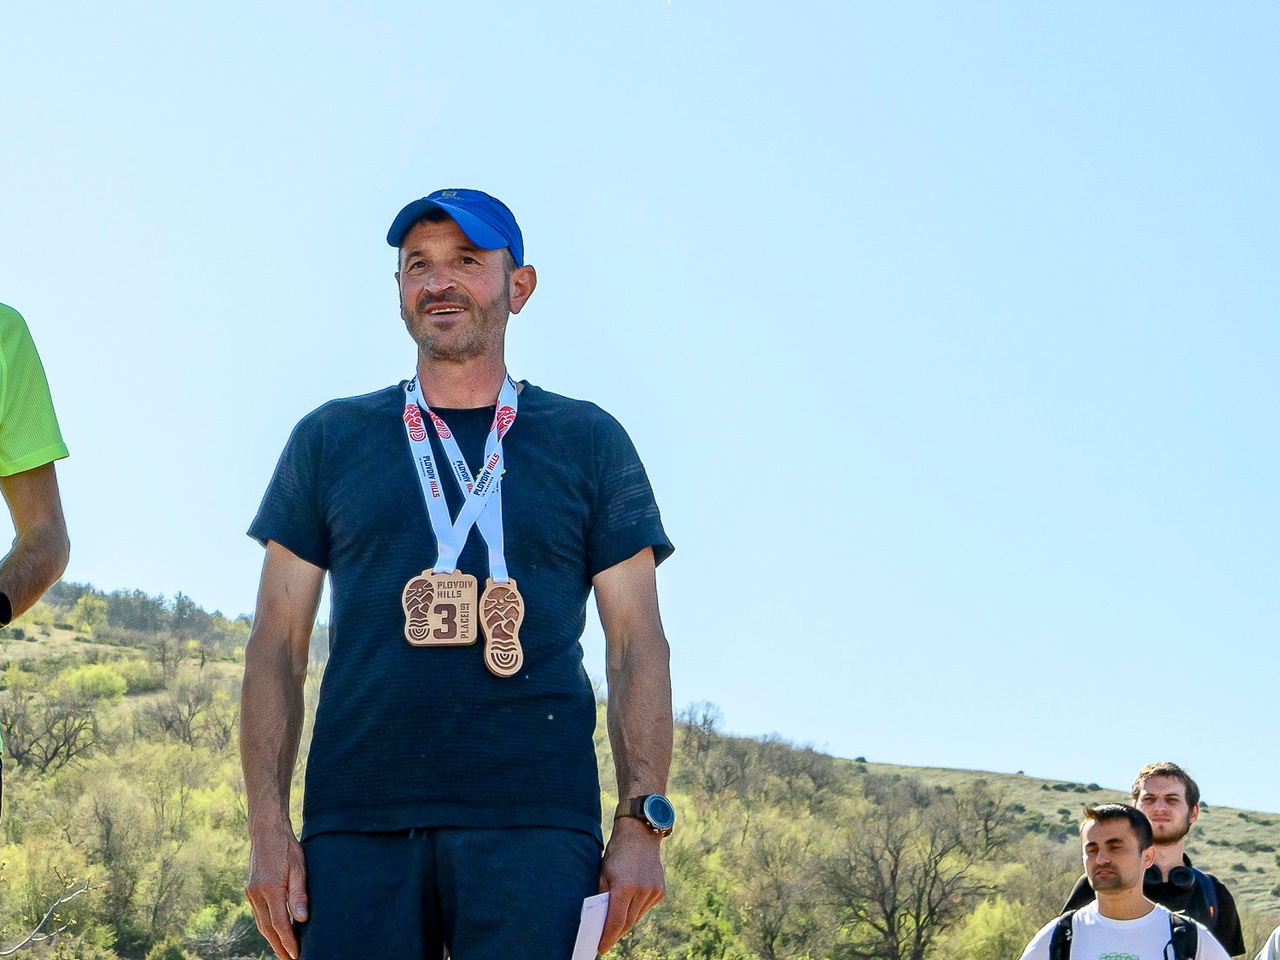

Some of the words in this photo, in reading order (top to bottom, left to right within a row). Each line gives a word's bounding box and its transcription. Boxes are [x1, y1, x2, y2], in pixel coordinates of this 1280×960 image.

[473, 469, 491, 496] PLOVDIV
[487, 453, 500, 471] HILLS
[430, 480, 441, 498] HILLS
[437, 580, 473, 590] PLOVDIV
[437, 590, 462, 599] HILLS
[433, 603, 457, 639] 3
